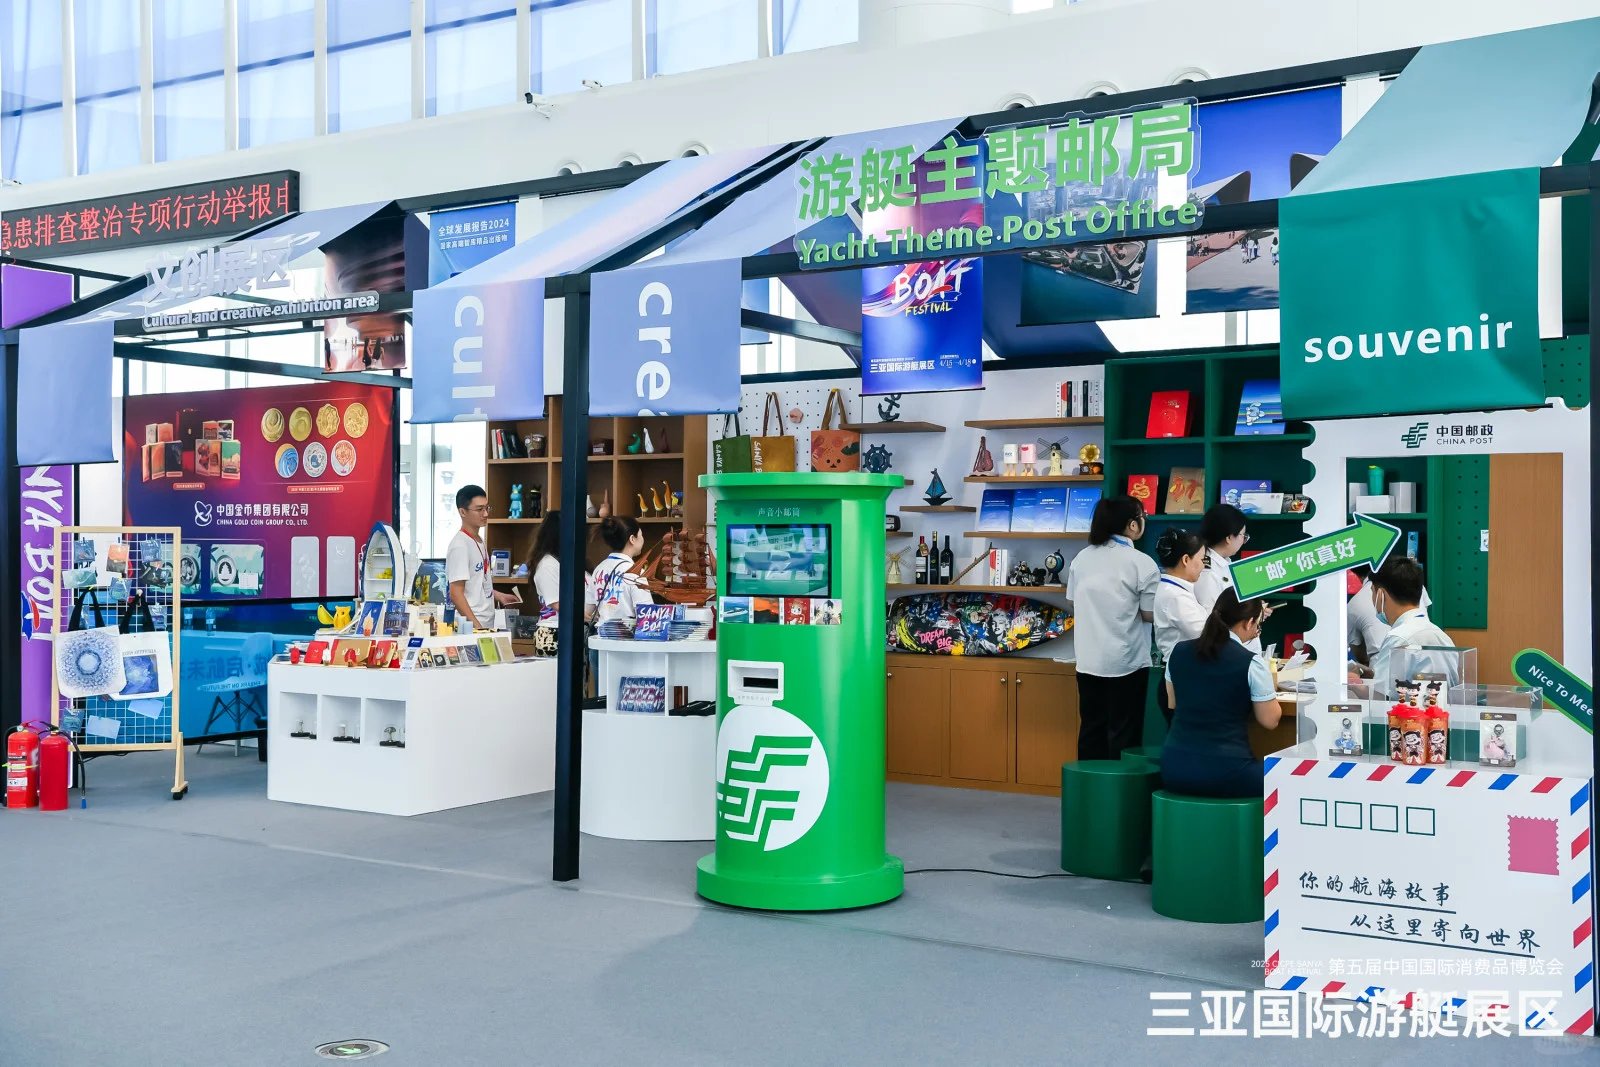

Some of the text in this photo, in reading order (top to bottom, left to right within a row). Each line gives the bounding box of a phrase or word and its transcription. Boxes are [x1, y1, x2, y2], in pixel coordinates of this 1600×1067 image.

[798, 104, 1195, 220] 游艇主题邮局
[438, 217, 510, 237] 全球发展报告2024
[798, 198, 1198, 264] Yacht Theme Post Office
[145, 240, 292, 303] 文创展区
[891, 263, 974, 305] BOAT
[143, 295, 376, 328] Cultural and creative exhibition area
[905, 301, 954, 317] FESTIVAL
[636, 281, 673, 416] cre
[1304, 312, 1513, 363] souvenir
[870, 360, 936, 373] 三亚国际游艇展区
[1436, 424, 1494, 437] 中国邮政
[216, 503, 309, 517] 中国金币集团有限公司
[757, 507, 800, 518] 声音小邮筒
[637, 606, 671, 619] SANYA
[919, 628, 945, 645] DREAM
[937, 636, 952, 648] BIG
[1528, 665, 1554, 687] Nice
[1555, 682, 1569, 697] To
[1299, 871, 1451, 906] 你的航海故事
[1350, 913, 1541, 953] 从这里寄向世界
